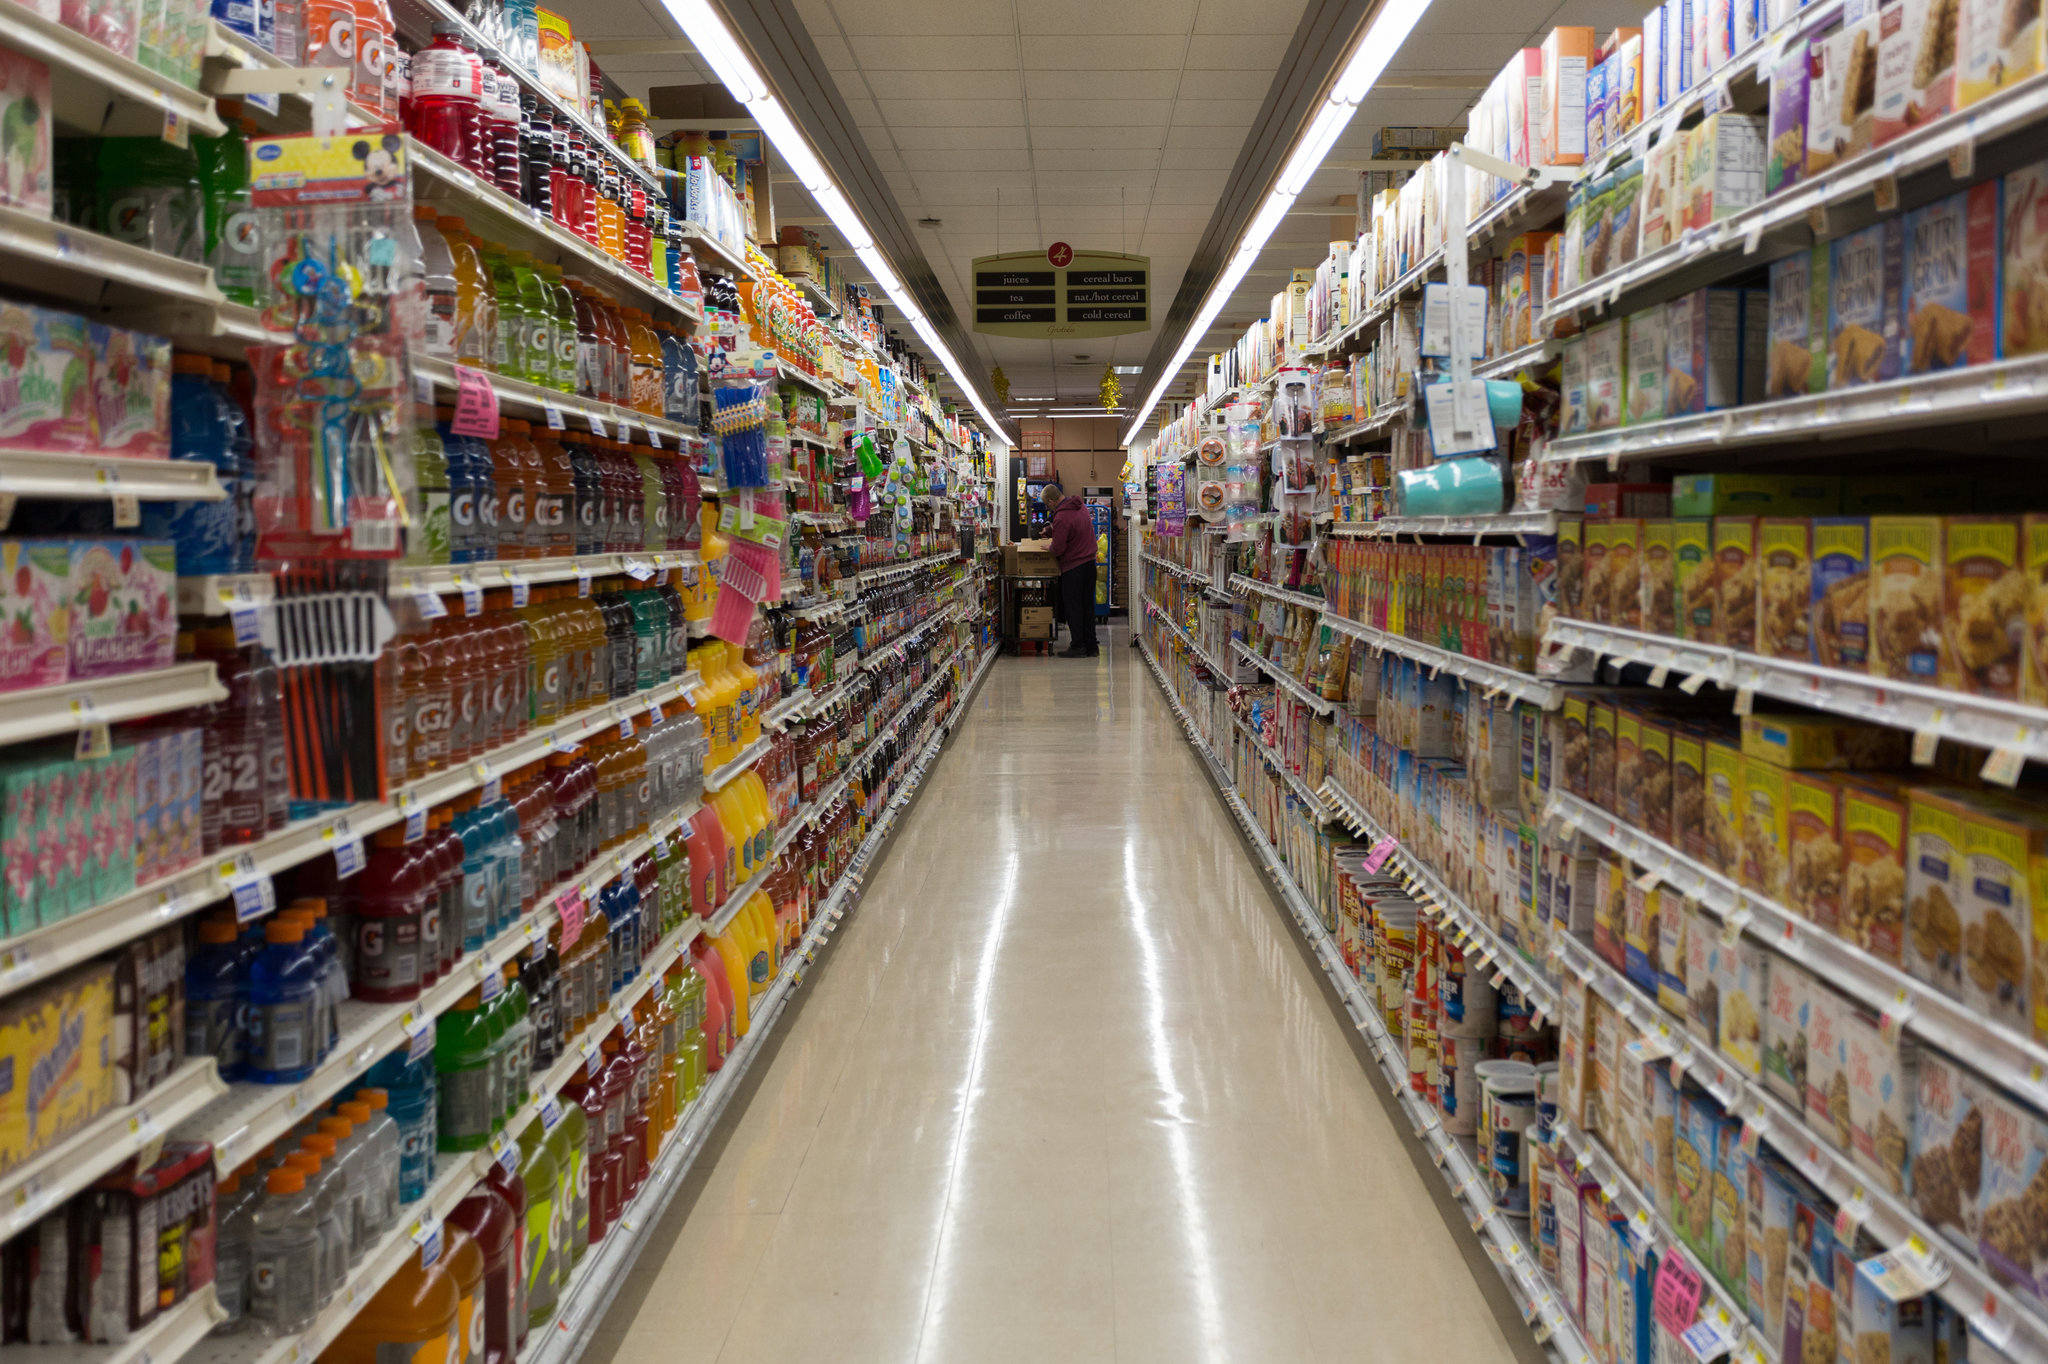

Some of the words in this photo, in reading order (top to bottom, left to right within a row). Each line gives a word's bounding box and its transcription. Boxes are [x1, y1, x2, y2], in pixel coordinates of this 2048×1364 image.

[1053, 246, 1067, 262] 4
[1003, 274, 1030, 285] juices
[1083, 274, 1110, 283] cereal
[1113, 274, 1133, 283] bars
[1010, 294, 1024, 302] tea
[1112, 292, 1139, 301] cereal
[1004, 311, 1032, 320] coffee
[1082, 310, 1101, 319] cold
[1104, 310, 1131, 319] cereal
[454, 494, 475, 526] G
[361, 922, 384, 956] G
